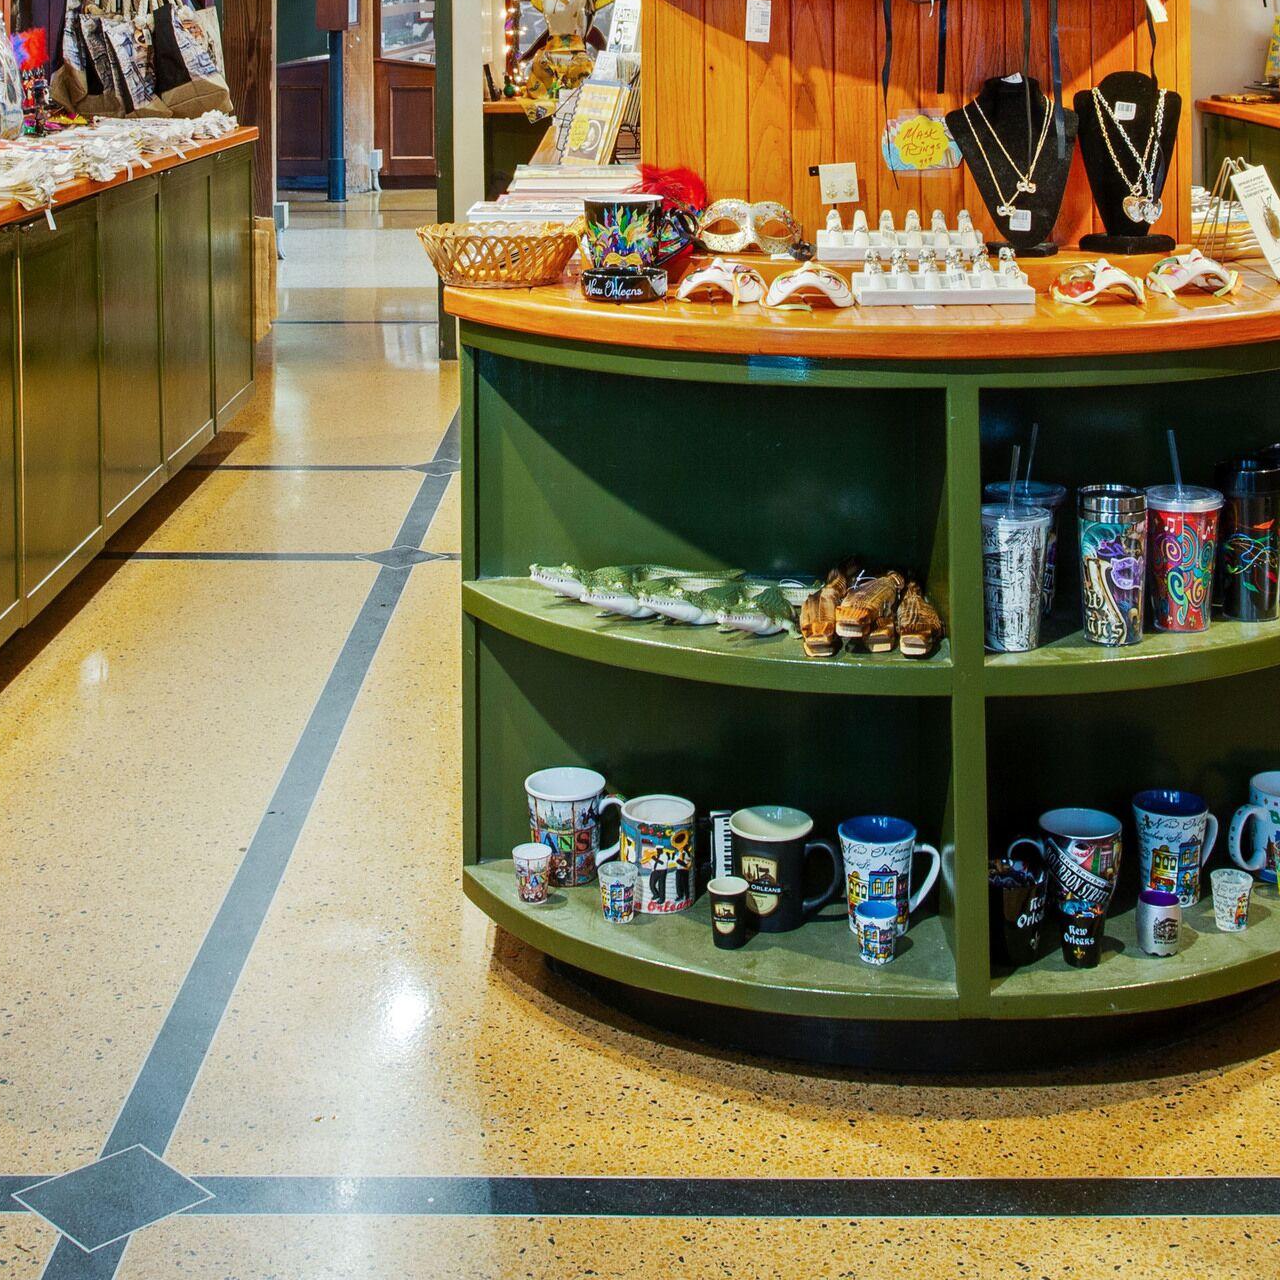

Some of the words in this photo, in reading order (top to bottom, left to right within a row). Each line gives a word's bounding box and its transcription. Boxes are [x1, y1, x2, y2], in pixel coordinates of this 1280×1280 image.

[586, 277, 604, 297] New
[605, 276, 644, 298] Orleans
[750, 883, 782, 893] ORLEANS
[1068, 925, 1088, 936] New
[1064, 933, 1095, 946] Orleans
